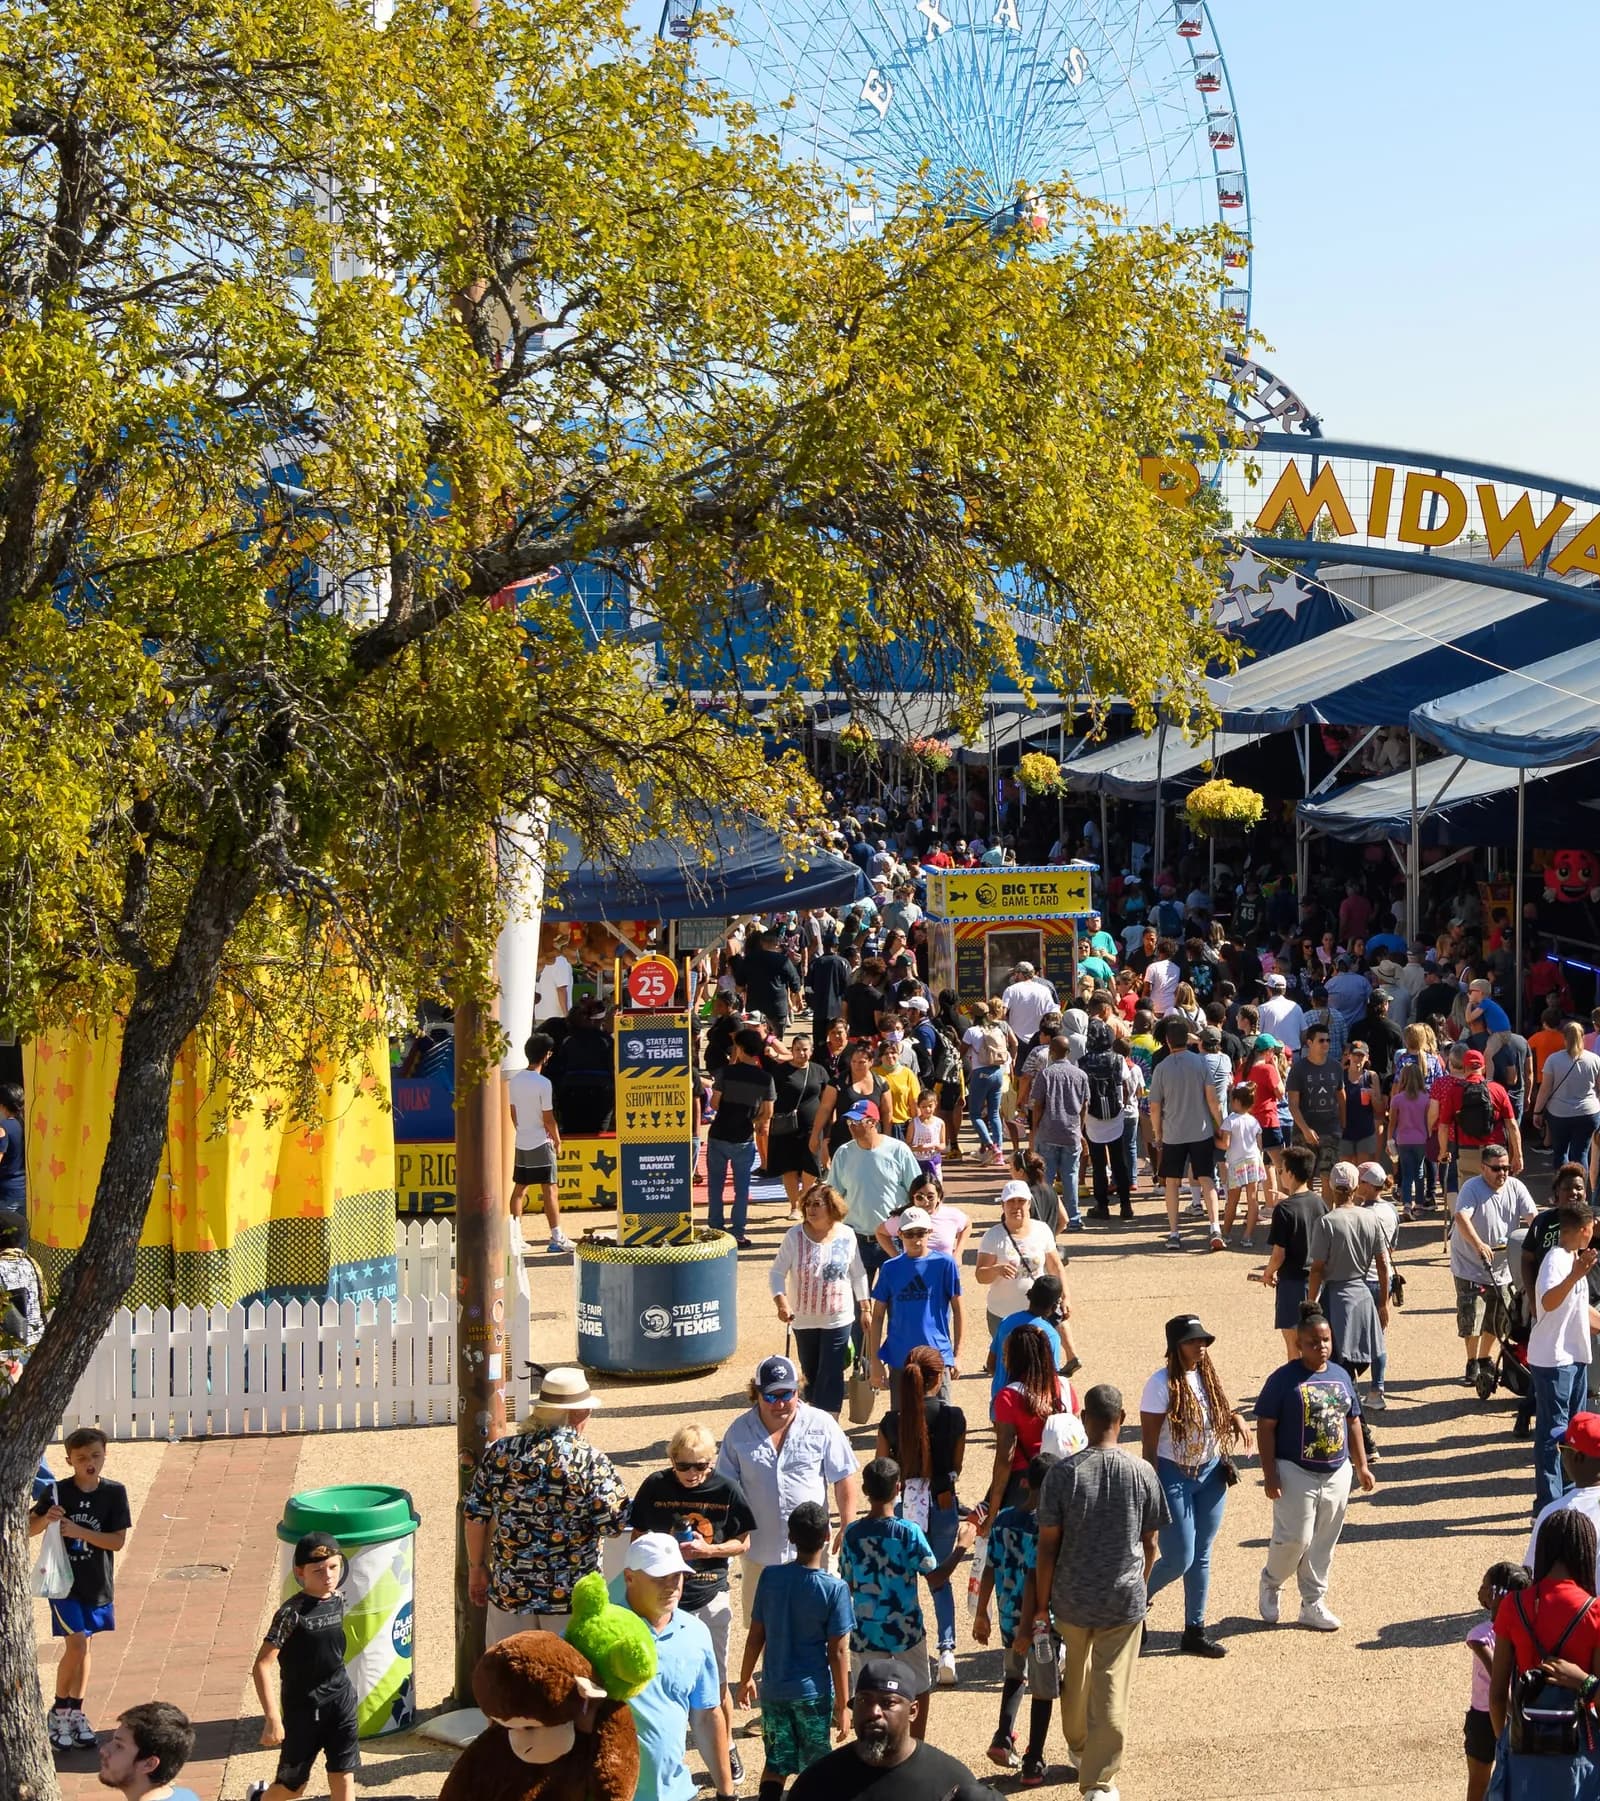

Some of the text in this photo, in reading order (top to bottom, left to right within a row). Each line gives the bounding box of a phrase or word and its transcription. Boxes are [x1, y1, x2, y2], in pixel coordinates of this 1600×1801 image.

[1001, 882, 1058, 895] BIG TEX
[1001, 895, 1059, 907] GAME CARD
[637, 976, 666, 996] 25
[646, 1037, 684, 1046] STATE FAIR
[646, 1048, 685, 1060] TEXAS
[625, 1090, 686, 1108] SHOWTIMES
[639, 1155, 676, 1163] MIDWAY
[639, 1162, 676, 1170] BARKER
[420, 1154, 456, 1186] RIG
[376, 1282, 398, 1299] FAIR
[587, 1303, 602, 1316] FAIR
[672, 1299, 720, 1316] STATE FAIR
[578, 1319, 604, 1337] EXAS
[672, 1315, 721, 1337] TEXAS
[394, 1613, 413, 1629] PLAS
[392, 1623, 413, 1641] BOTT
